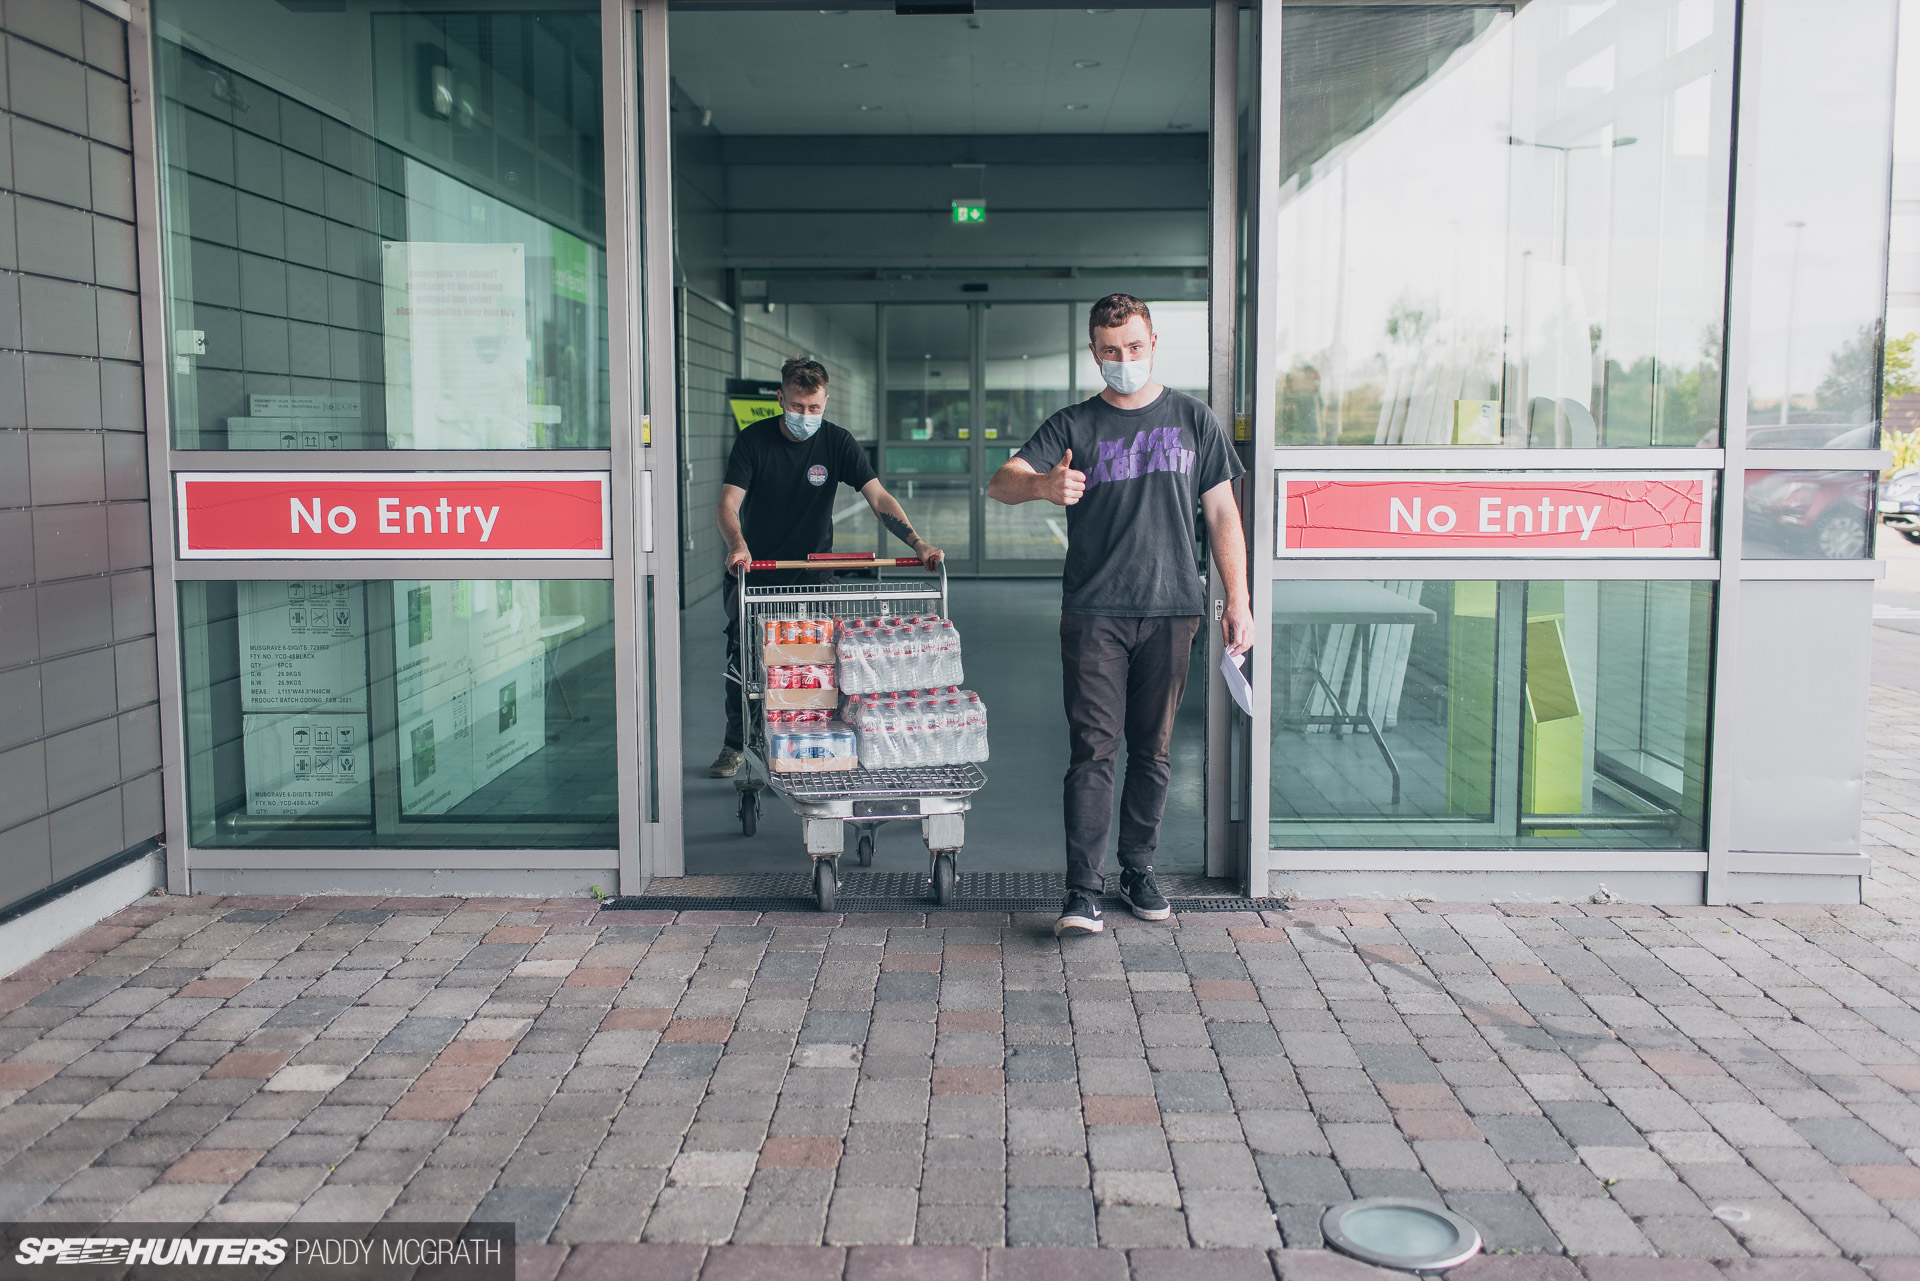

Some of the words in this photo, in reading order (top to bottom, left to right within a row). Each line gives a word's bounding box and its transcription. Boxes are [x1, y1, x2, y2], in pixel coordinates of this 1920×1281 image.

[1098, 426, 1182, 462] BLACK
[290, 497, 357, 534] No
[378, 497, 500, 542] Entry
[1389, 496, 1457, 533] No
[1478, 496, 1602, 541] Entry
[249, 644, 282, 652] MUSGRAVE
